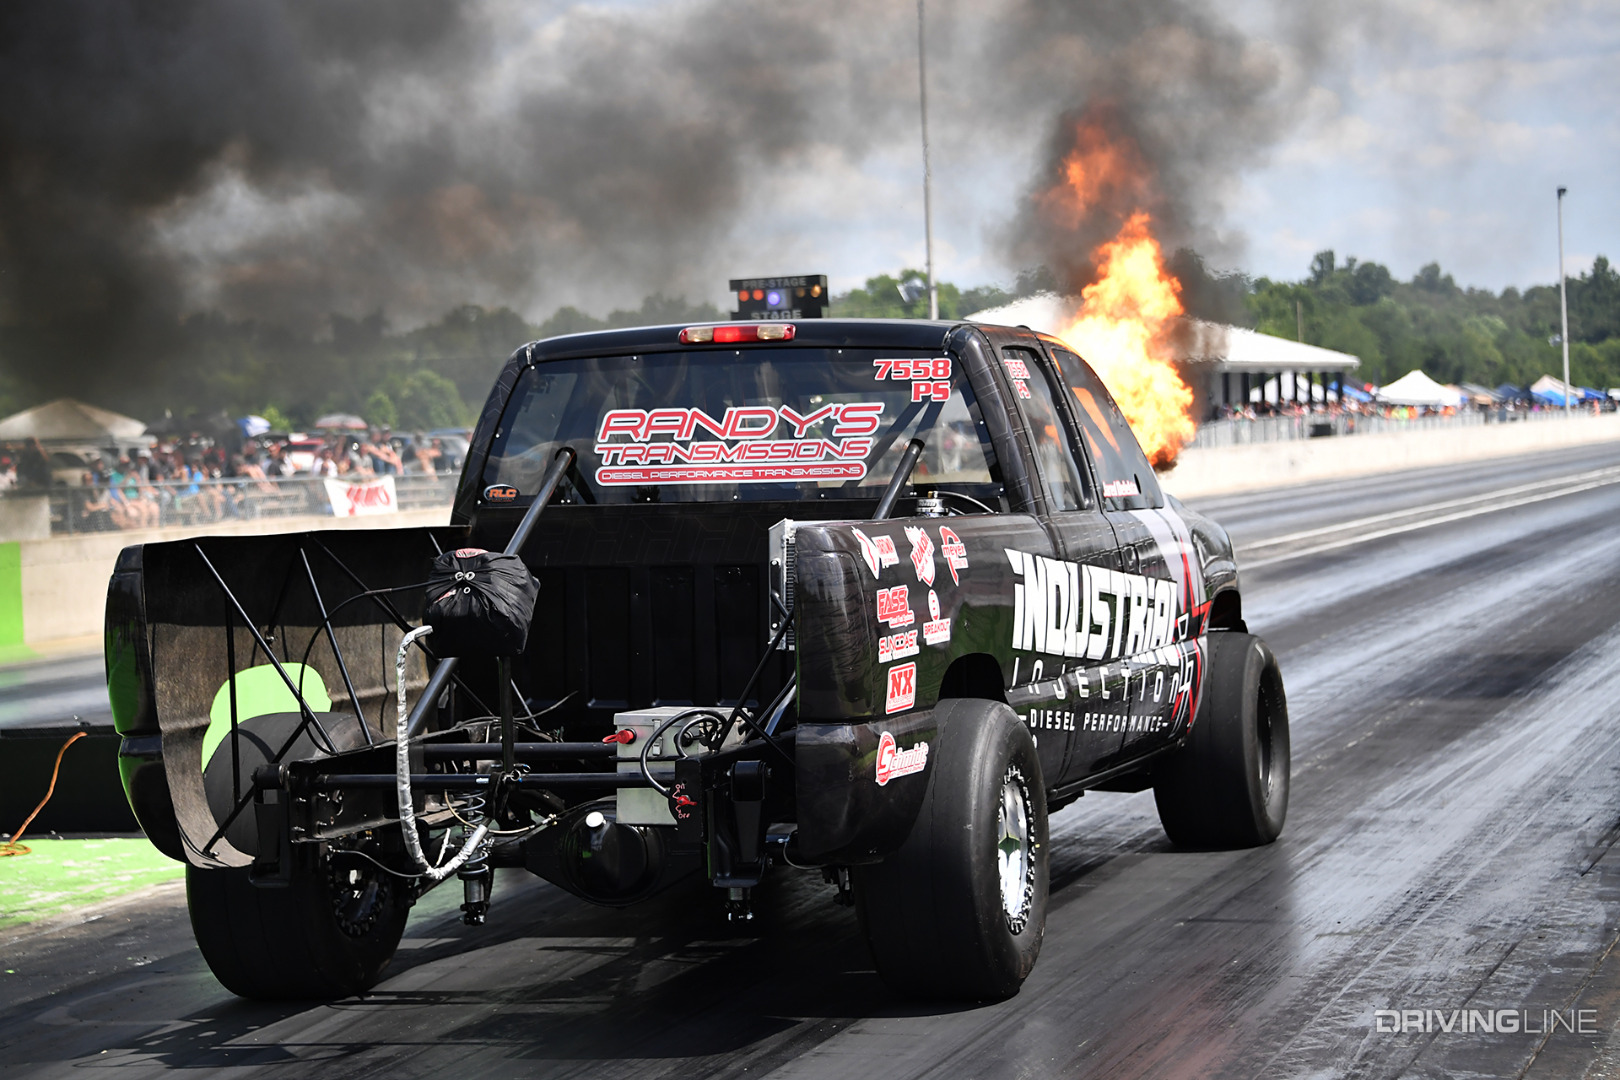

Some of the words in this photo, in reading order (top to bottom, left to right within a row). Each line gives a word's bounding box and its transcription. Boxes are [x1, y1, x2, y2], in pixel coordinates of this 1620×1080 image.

[750, 309, 802, 320] STAGE
[873, 358, 951, 380] 7558
[1003, 359, 1031, 379] 7558
[911, 380, 951, 402] PS
[598, 402, 885, 442] RANDY'S
[595, 437, 874, 466] TRANSMISSIONS
[601, 470, 649, 481] DIESEL
[650, 468, 753, 480] PERFORMANCE
[754, 466, 861, 478] TRANSMISSIONS
[489, 488, 518, 498] RLC
[943, 544, 965, 558] meyer
[878, 586, 908, 615] FASS
[924, 620, 950, 636] BREAKOUT
[879, 630, 918, 656] SUNCOAST
[889, 669, 914, 699] NX
